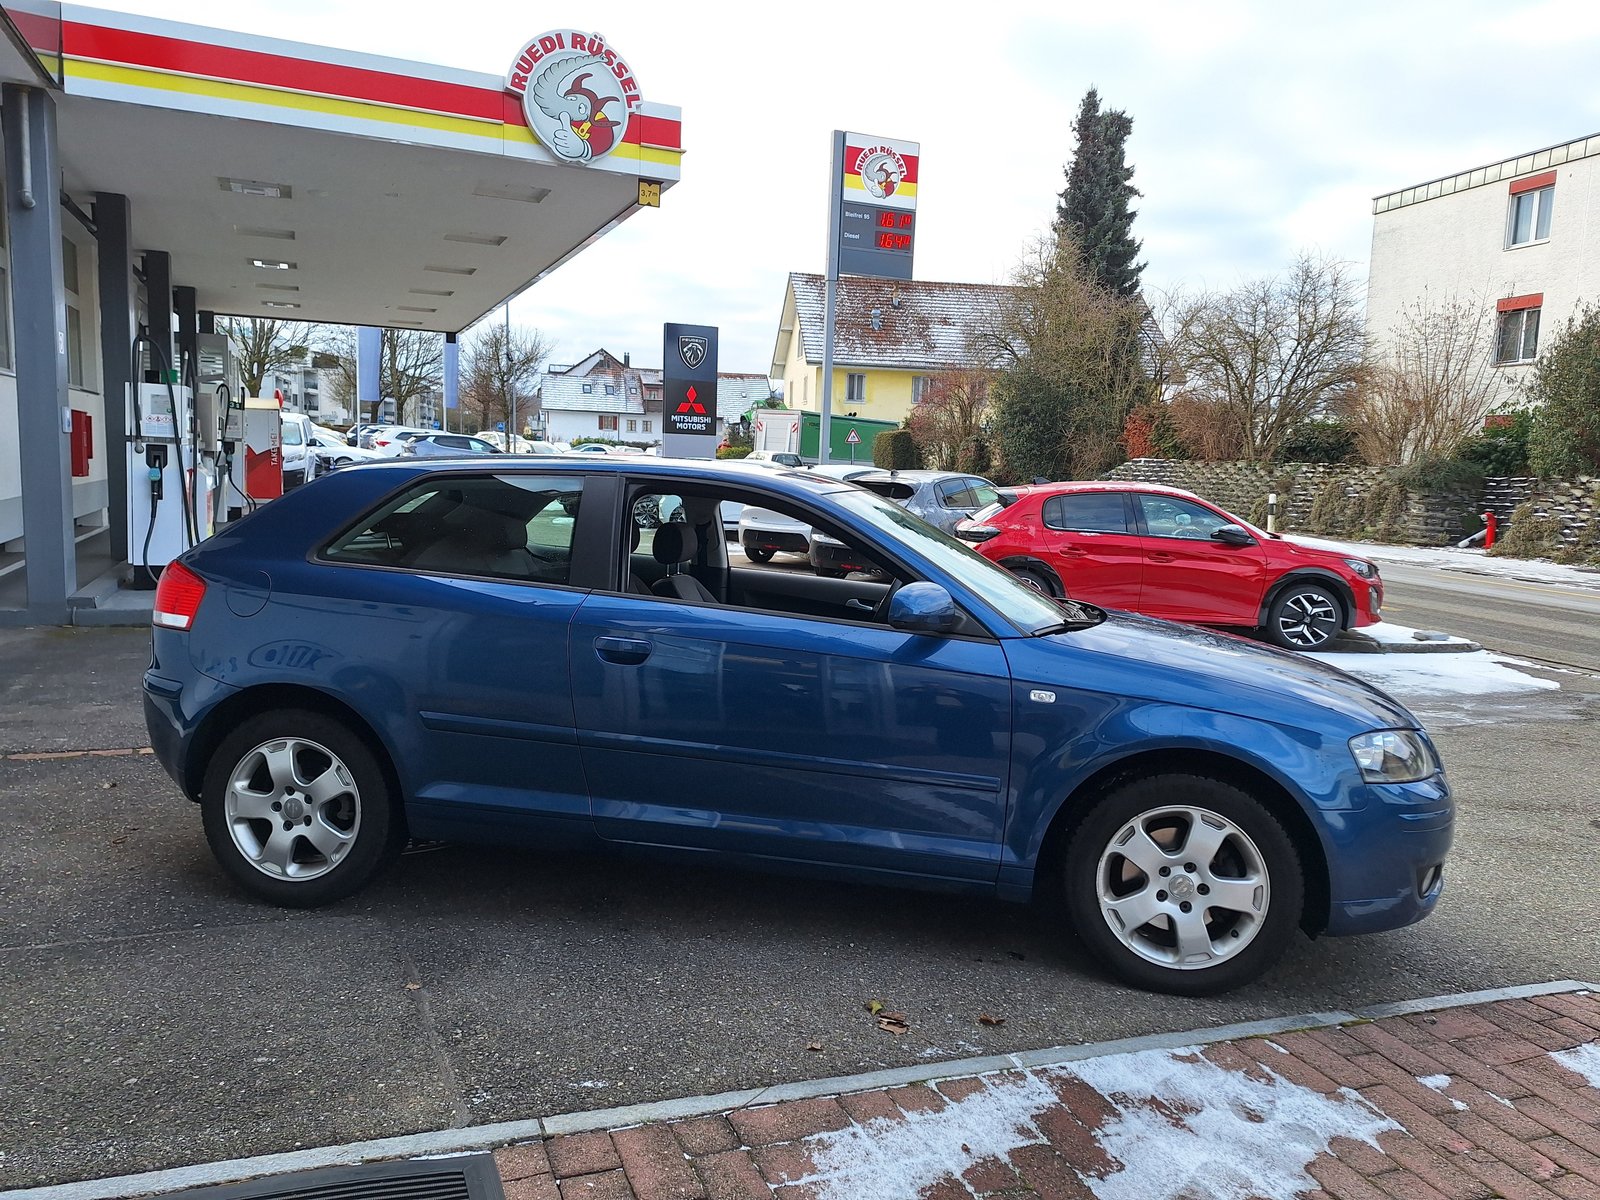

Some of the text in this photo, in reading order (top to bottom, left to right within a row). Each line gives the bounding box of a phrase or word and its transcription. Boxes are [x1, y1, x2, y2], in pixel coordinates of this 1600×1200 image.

[510, 32, 641, 109] RUEDI RÜSSEL
[856, 145, 906, 176] RUEDI RÜSSEL
[845, 211, 863, 219] Bleifrei
[844, 232, 860, 240] Diesel
[671, 414, 711, 424] MITSUBISHI
[676, 422, 706, 431] MOTORS
[270, 447, 278, 466] TAKE
